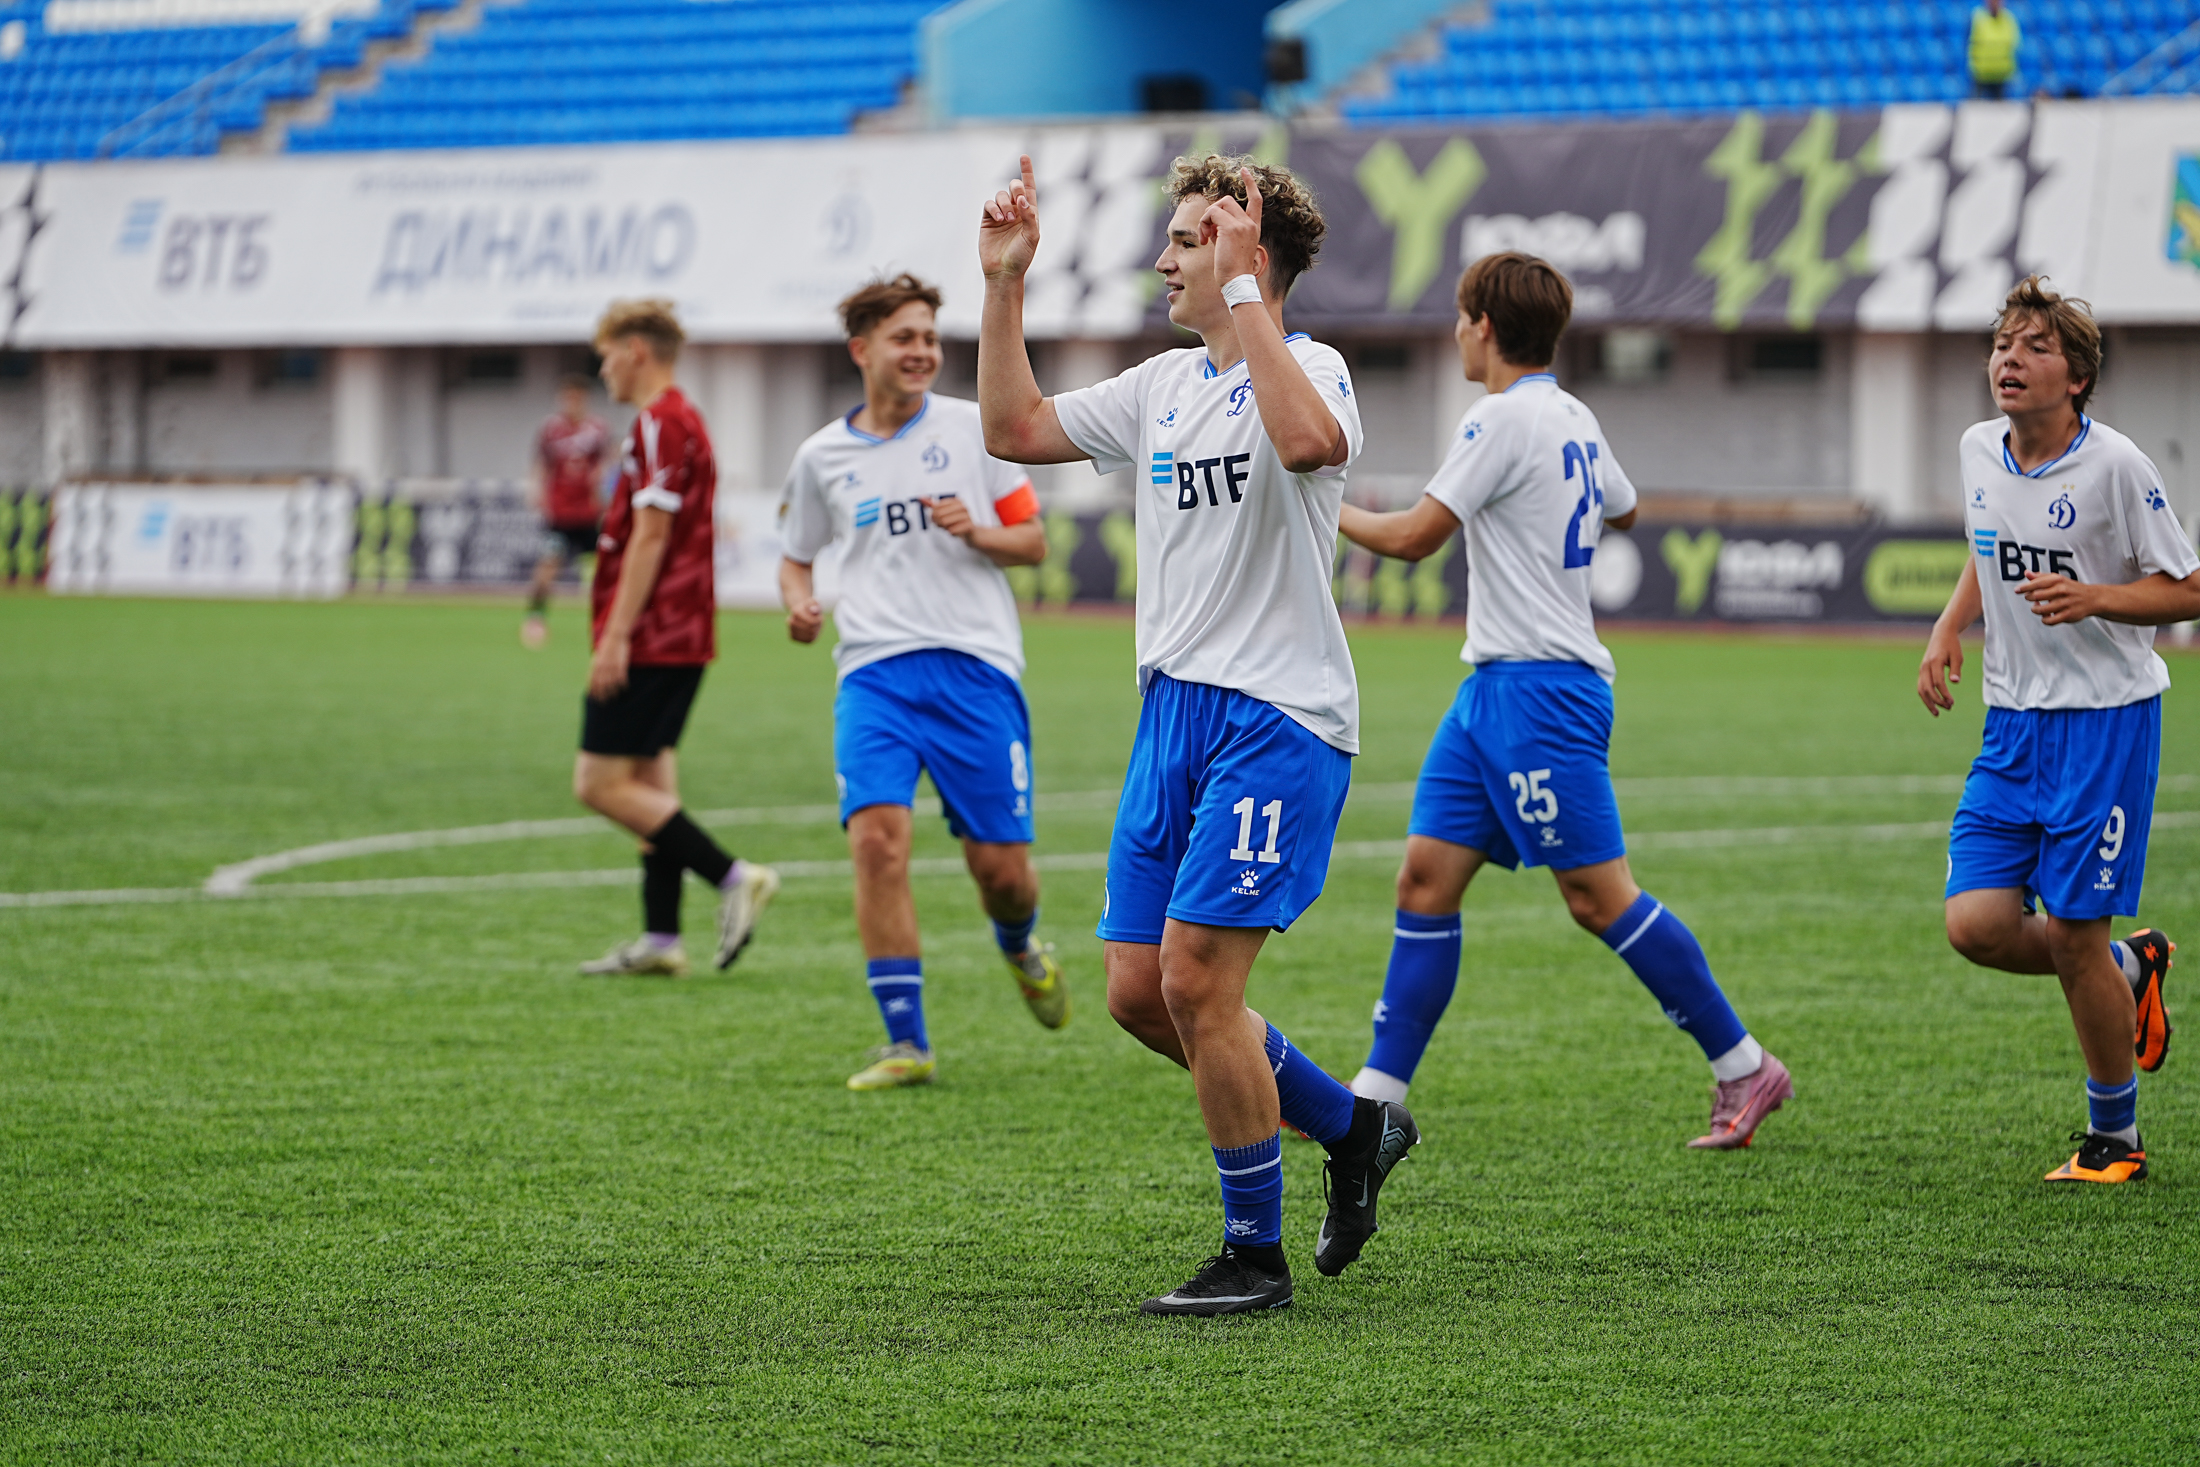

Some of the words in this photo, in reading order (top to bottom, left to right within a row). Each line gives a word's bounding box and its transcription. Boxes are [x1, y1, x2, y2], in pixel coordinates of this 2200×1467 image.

[157, 212, 273, 292] ВТБ
[371, 202, 697, 297] ДИНАМО
[886, 494, 957, 535] ВТ
[1998, 540, 2079, 582] ВТБ
[1009, 740, 1029, 793] 8
[1508, 768, 1559, 824] 25
[1230, 796, 1283, 864] 11
[2099, 805, 2126, 862] 9
[1231, 886, 1260, 896] KELME
